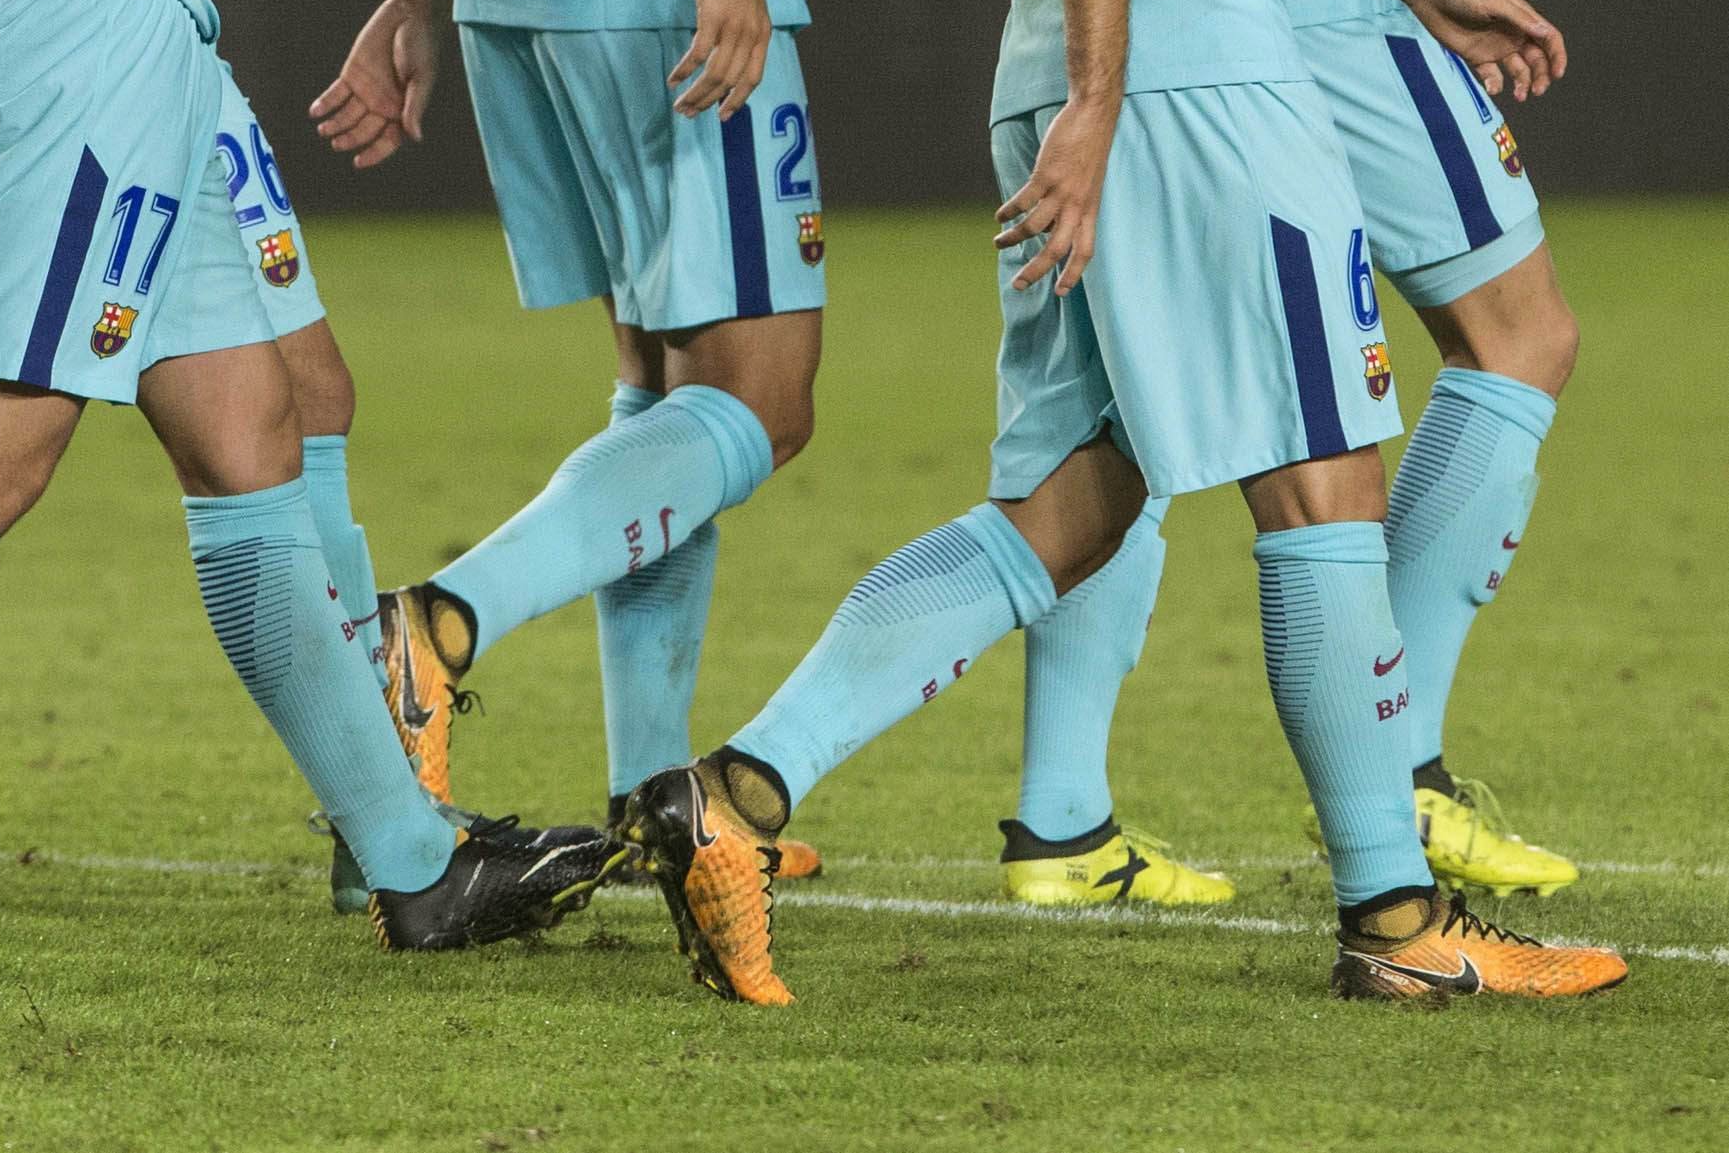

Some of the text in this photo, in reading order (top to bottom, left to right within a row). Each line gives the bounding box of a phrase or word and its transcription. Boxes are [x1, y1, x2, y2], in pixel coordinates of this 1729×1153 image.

[215, 123, 292, 229] 26
[771, 102, 812, 202] 2
[103, 185, 180, 295] 17
[1347, 229, 1379, 331] 6
[1375, 688, 1409, 722] BA
